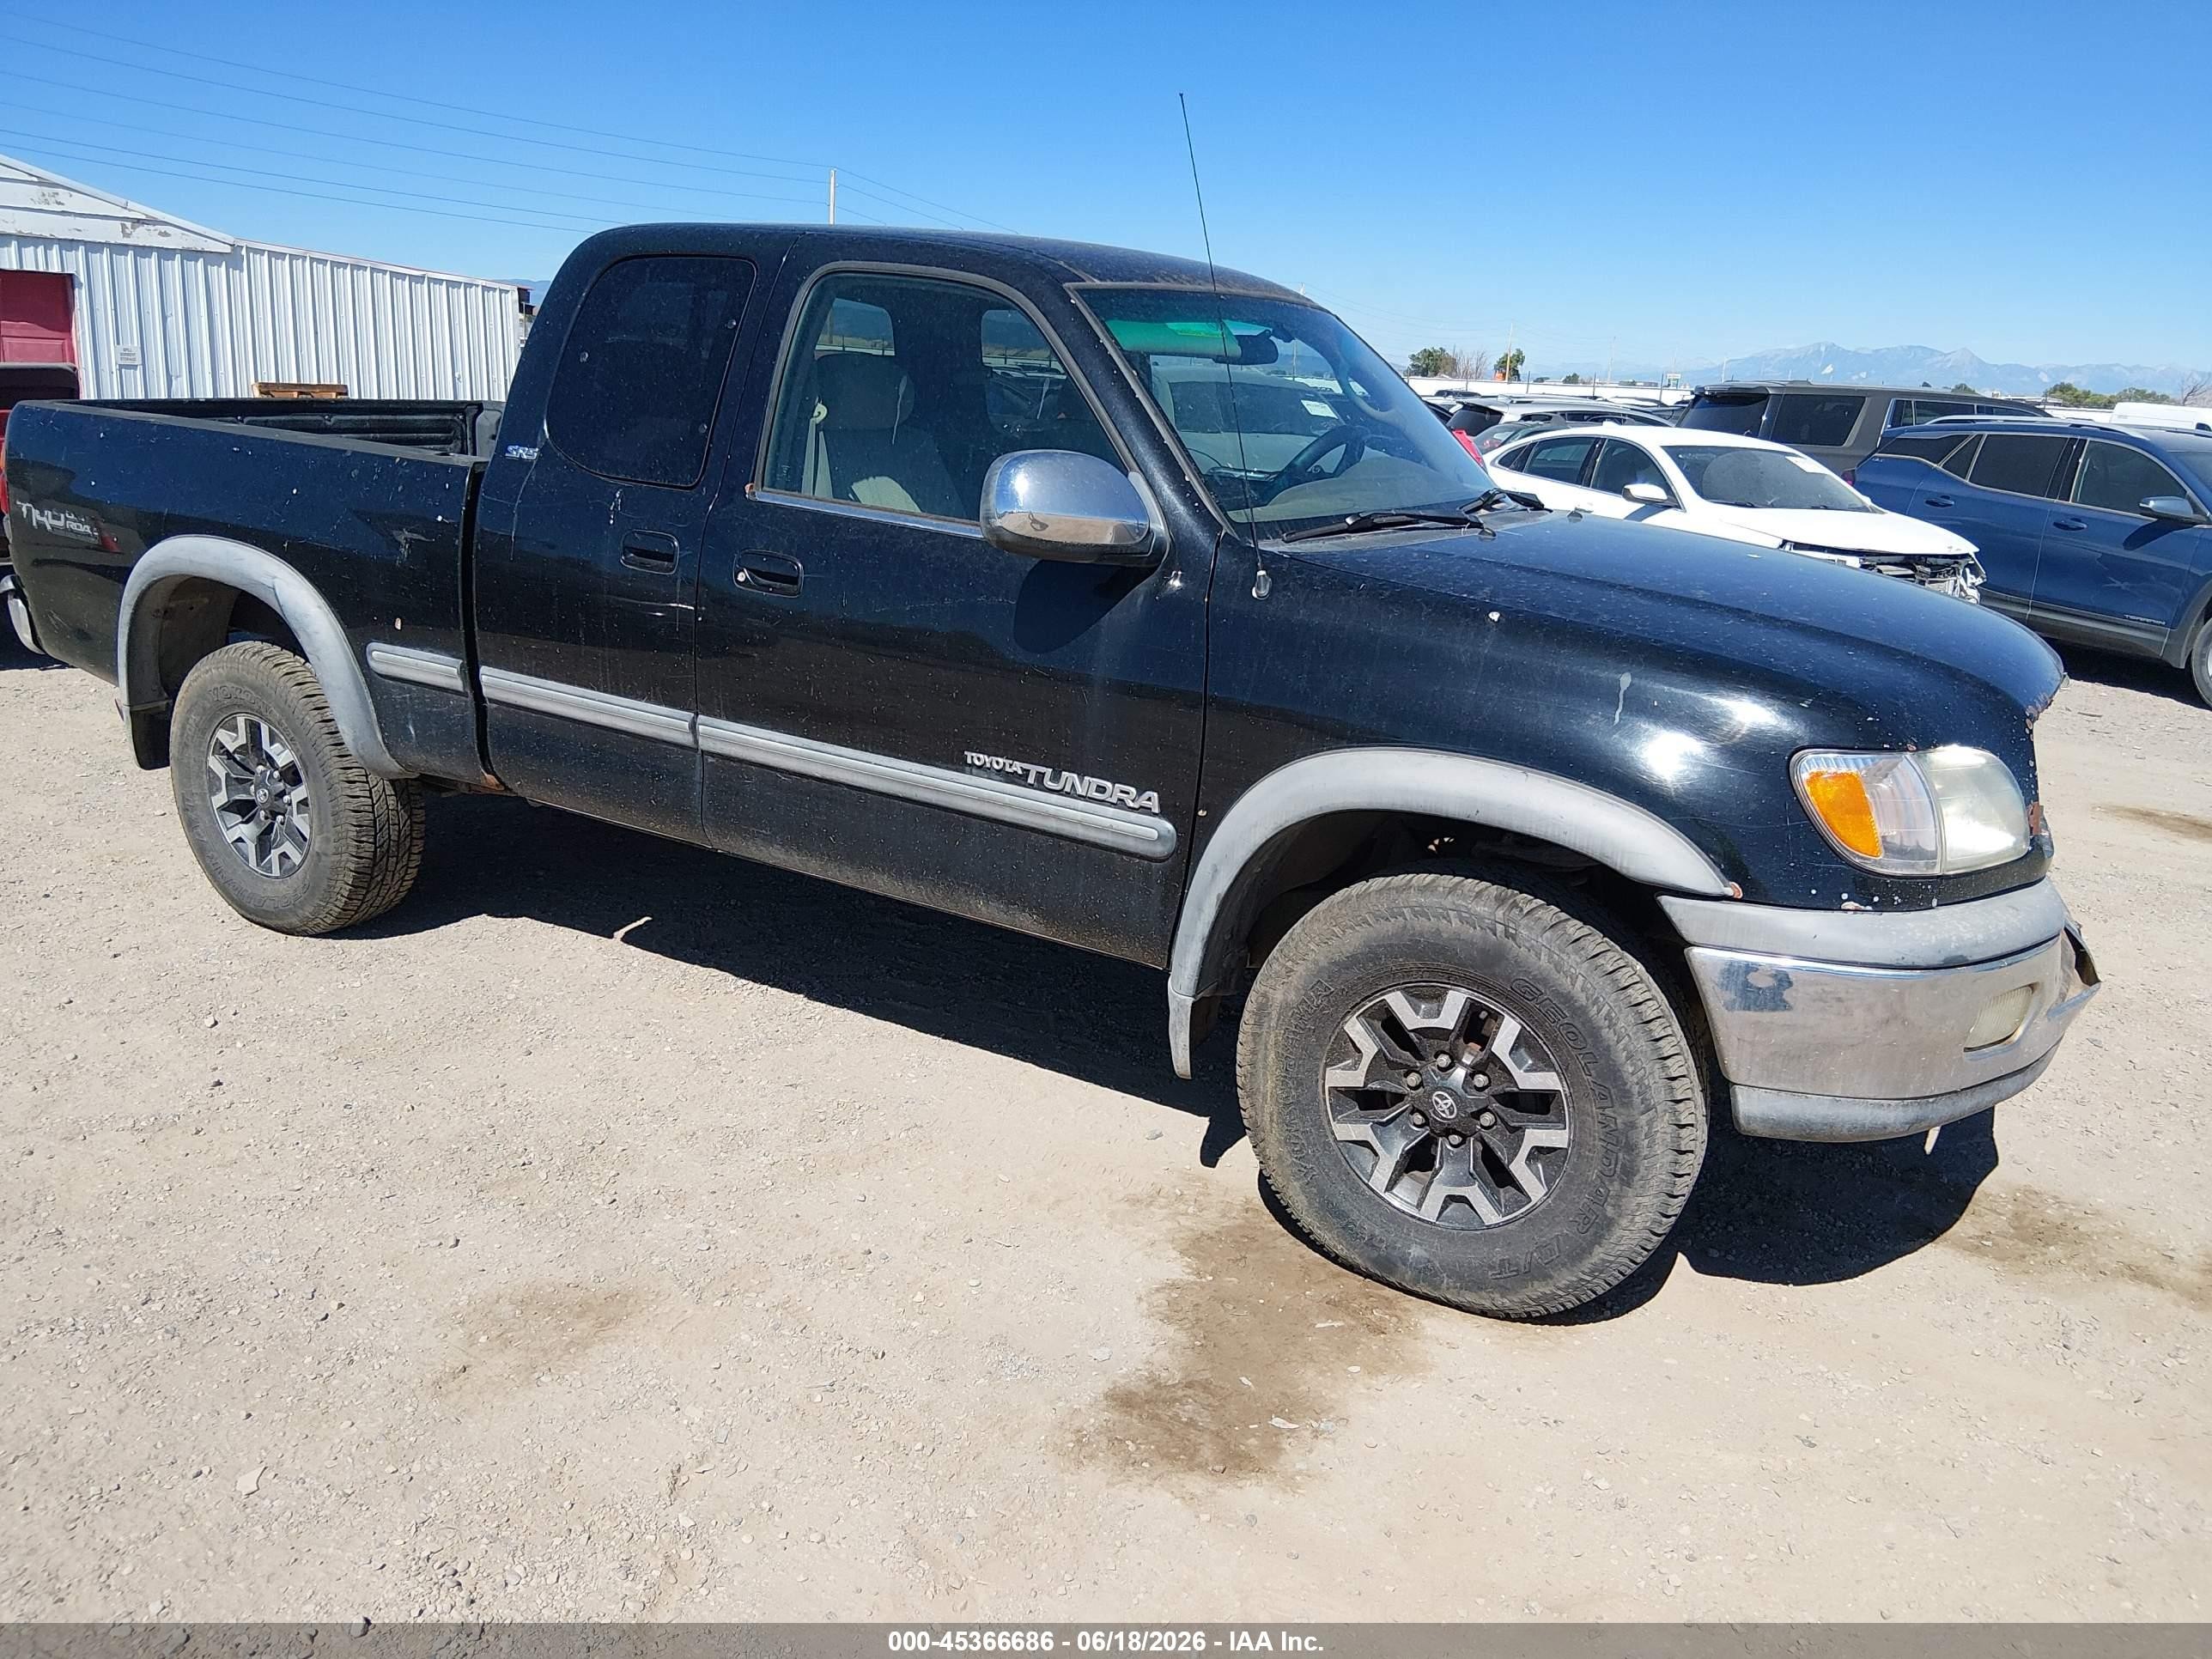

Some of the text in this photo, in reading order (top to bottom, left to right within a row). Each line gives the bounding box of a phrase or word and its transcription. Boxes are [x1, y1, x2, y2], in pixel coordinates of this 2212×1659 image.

[964, 750, 1161, 814] TOYOTA TUNDRA
[1511, 978, 1619, 1235] GEOLANDAR
